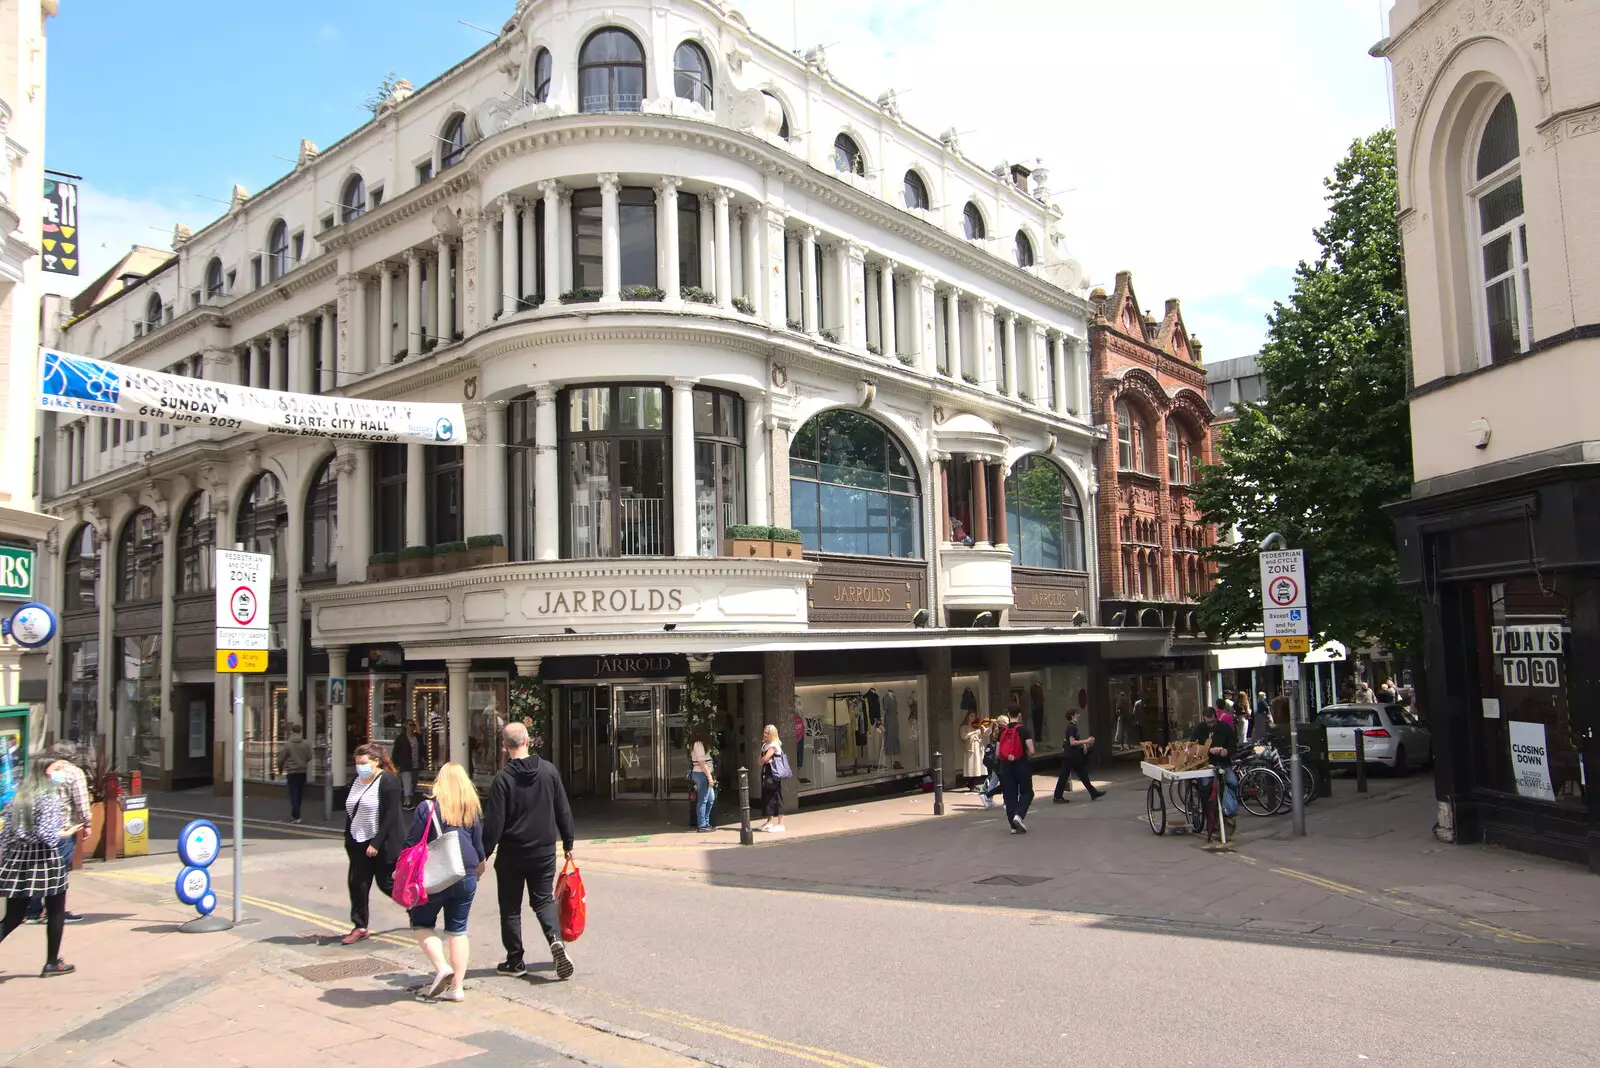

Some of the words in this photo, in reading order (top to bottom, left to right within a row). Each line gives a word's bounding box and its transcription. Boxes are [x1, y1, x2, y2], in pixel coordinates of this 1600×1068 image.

[42, 397, 69, 408] Bike
[77, 401, 116, 413] Events
[160, 397, 218, 414] SUNDAY
[139, 406, 164, 418] 6th
[169, 411, 202, 424] June
[209, 416, 242, 429] 2021
[285, 414, 326, 427] START:
[332, 418, 355, 429] CITY
[360, 420, 389, 431] HALL
[267, 426, 400, 442] www.bike-events.co.uk
[225, 553, 263, 562] PEDESTRIAN
[1262, 551, 1301, 559] PEDESTRIAN
[231, 570, 257, 582] ZONE
[1268, 565, 1296, 573] ZONE
[538, 589, 682, 614] JARROLDS
[834, 586, 891, 602] JARROLDS
[1493, 627, 1503, 651] 7
[1510, 627, 1560, 651] DAYS
[594, 657, 671, 676] JARROLD
[1504, 660, 1528, 684] TO
[1532, 660, 1557, 684] GO
[1513, 744, 1544, 756] CLOSING
[1517, 755, 1541, 765] DOWN
